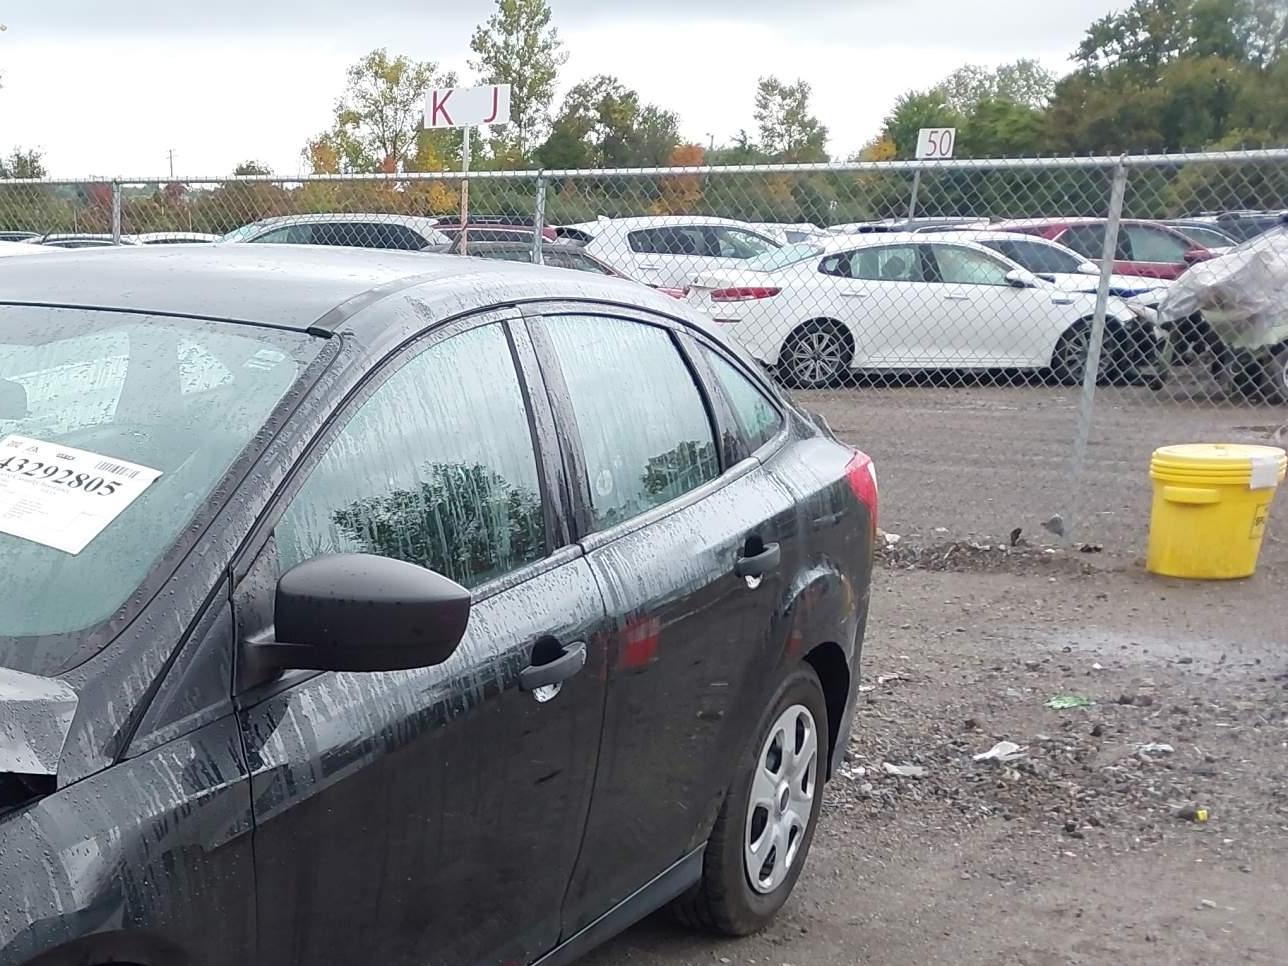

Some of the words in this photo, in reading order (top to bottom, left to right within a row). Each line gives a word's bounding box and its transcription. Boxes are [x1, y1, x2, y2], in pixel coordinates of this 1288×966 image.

[431, 89, 454, 126] K
[483, 86, 499, 123] J
[925, 129, 952, 157] 50
